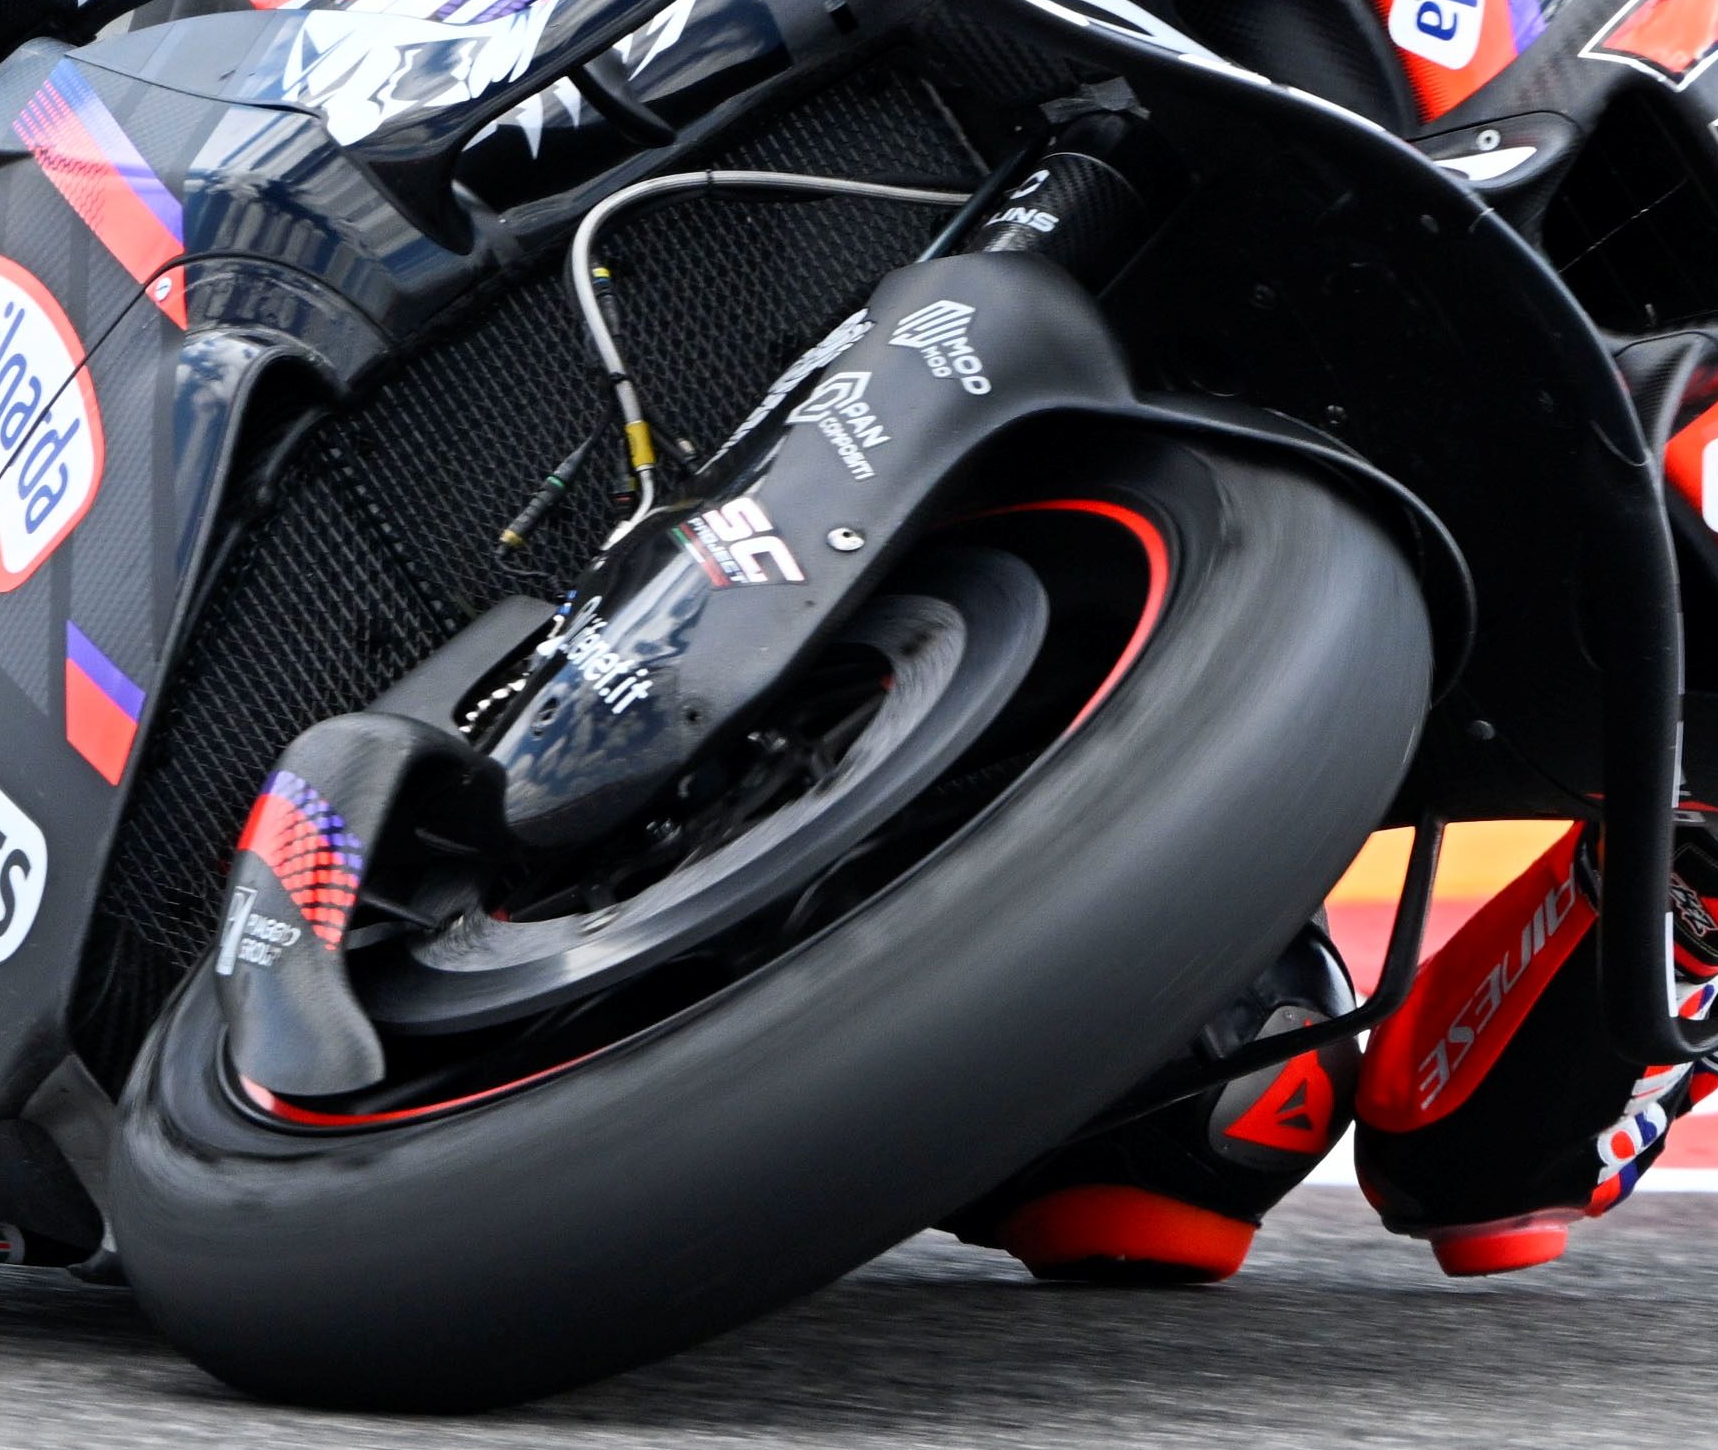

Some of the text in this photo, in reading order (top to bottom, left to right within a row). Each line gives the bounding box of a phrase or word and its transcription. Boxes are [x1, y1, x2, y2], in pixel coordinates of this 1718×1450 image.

[920, 346, 953, 378] MOD
[941, 336, 992, 395] MOD
[837, 401, 893, 448] PAN
[686, 516, 751, 584] PROJECT
[701, 496, 806, 583] SC
[1417, 860, 1578, 1112] AINESE
